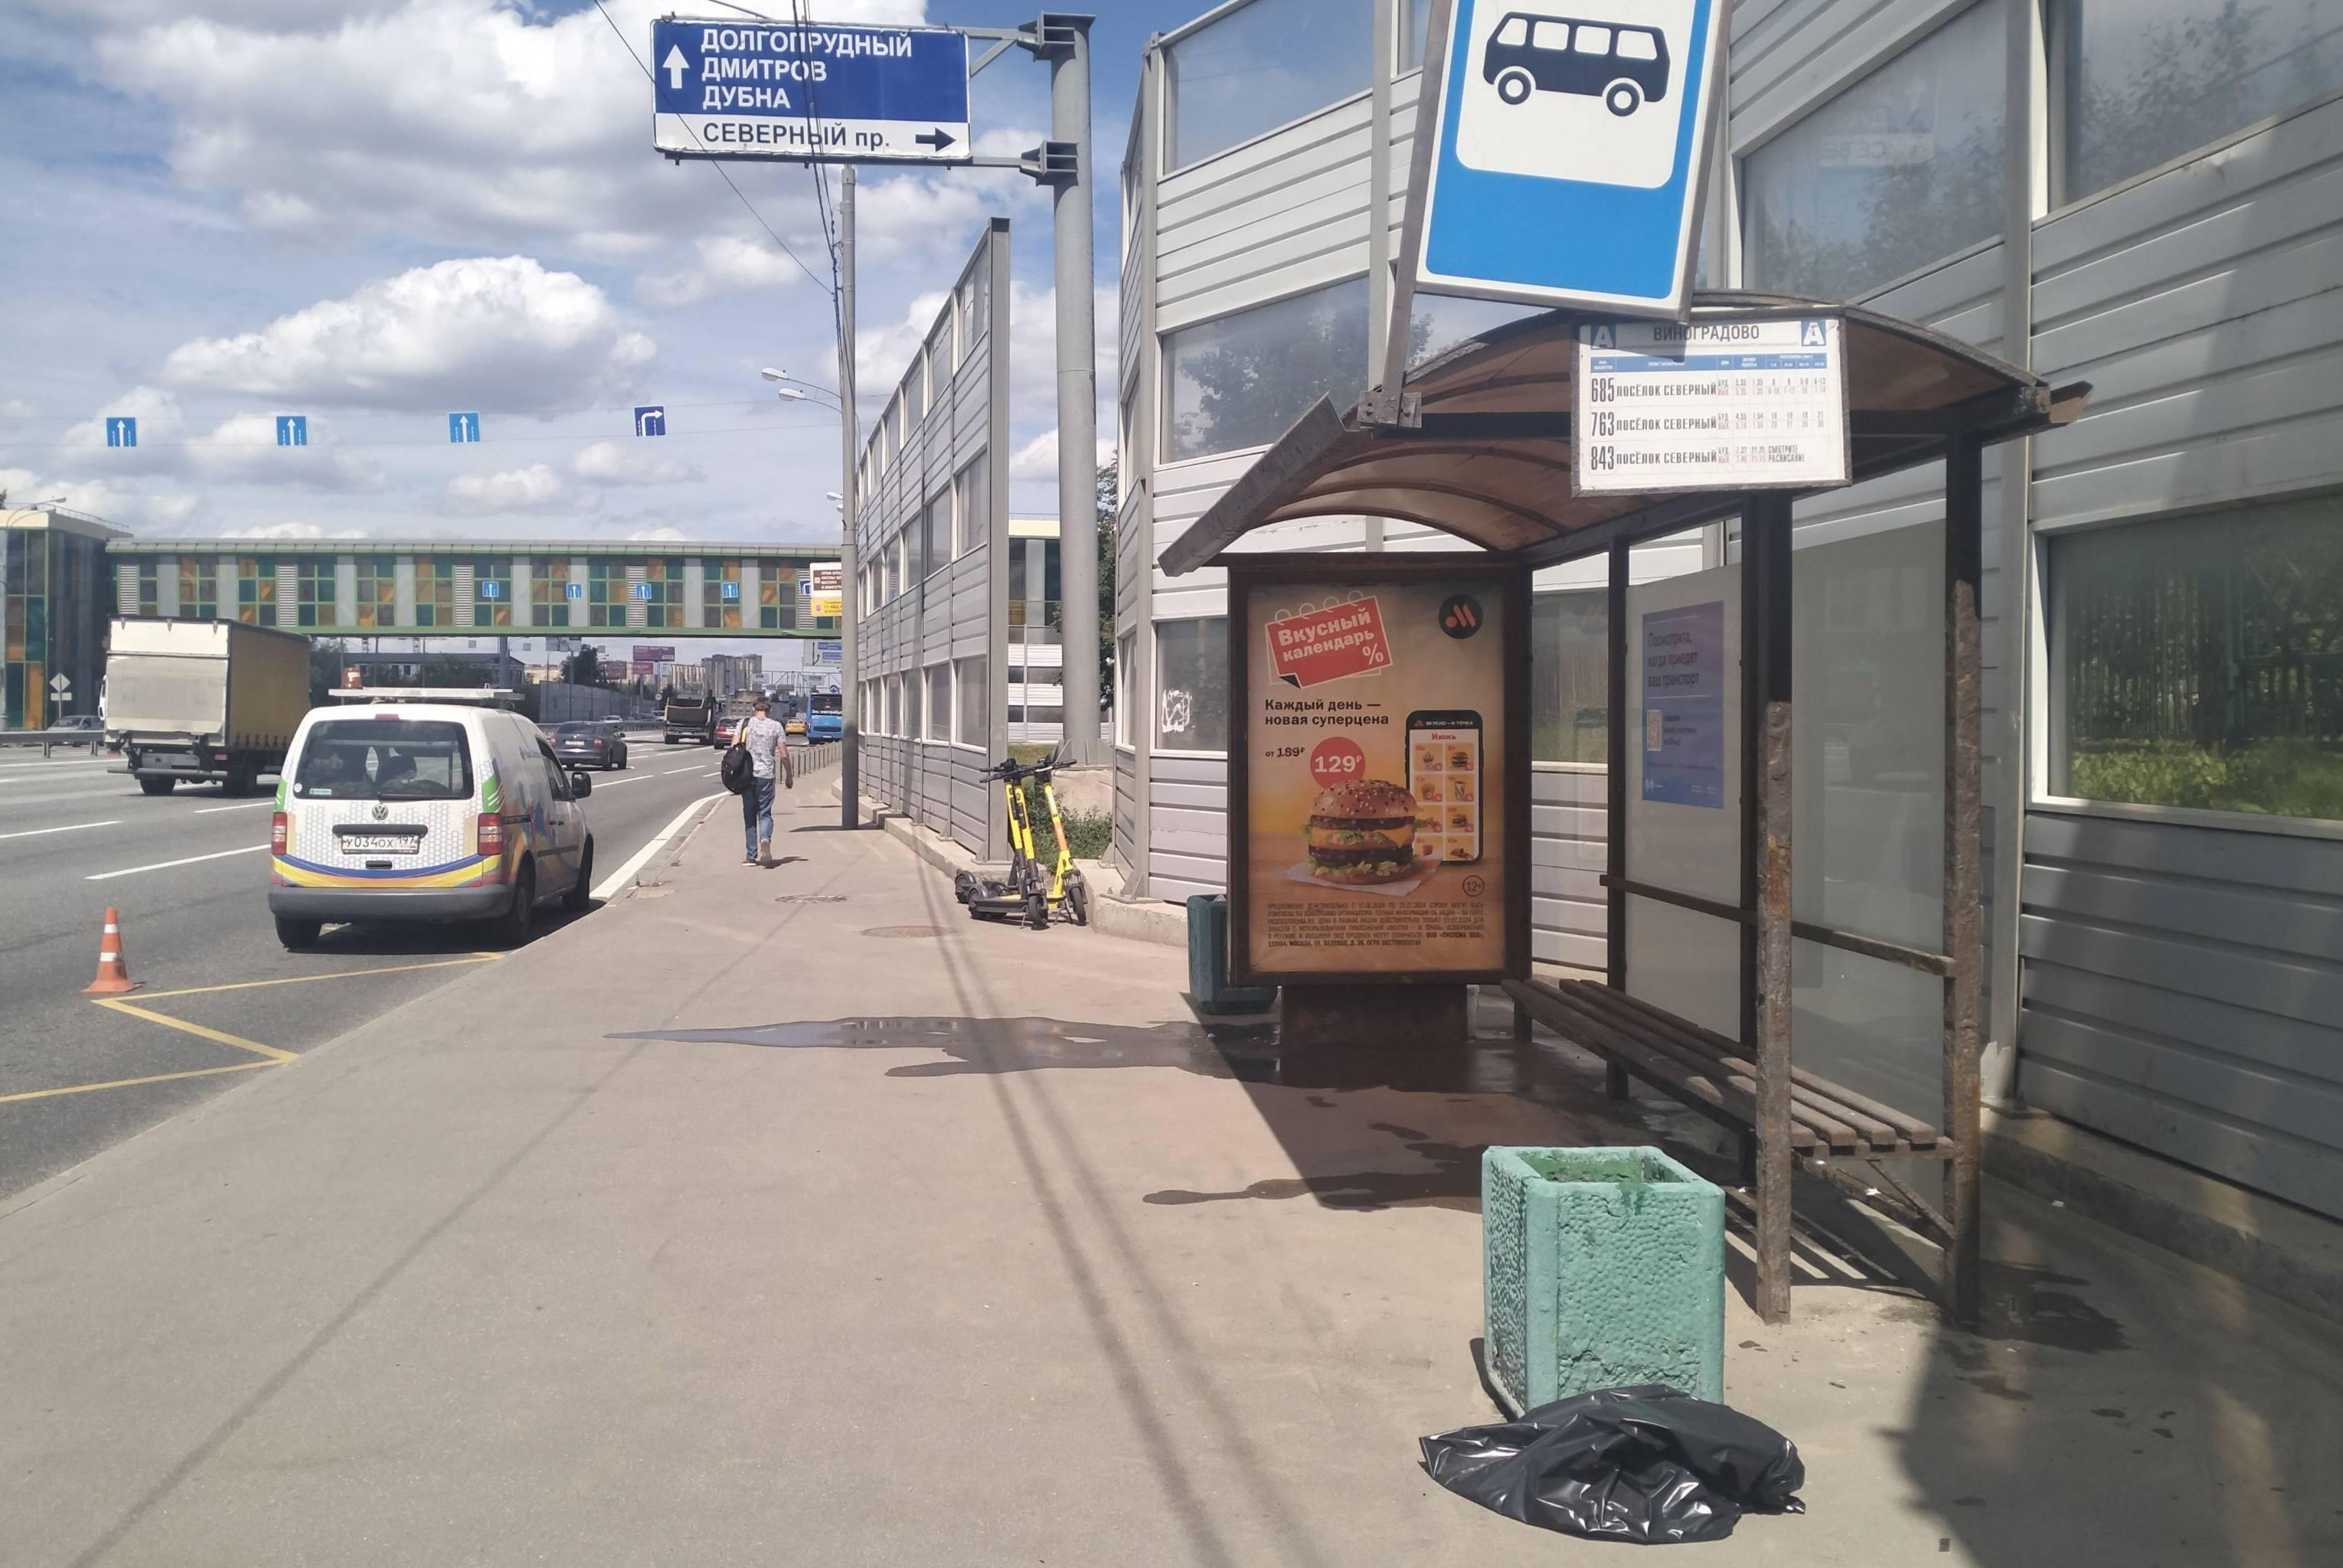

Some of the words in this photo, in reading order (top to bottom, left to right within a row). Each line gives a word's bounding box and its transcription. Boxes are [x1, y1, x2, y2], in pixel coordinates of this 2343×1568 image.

[701, 29, 912, 58] ДОЛГОПРУДНЫЙ
[701, 57, 827, 82] ДМИТРОВ
[702, 86, 791, 109] ДУБНА
[703, 122, 847, 146] СЕВЕРНЫЙ
[855, 131, 890, 151] пр.
[1654, 325, 1760, 341] ВИНОГРАДОВО
[1591, 377, 1615, 402] 685
[1664, 381, 1717, 396] СЕВЕРНЫЙ
[1591, 412, 1615, 436] 763
[1664, 416, 1717, 430] СЕВЕРНЫЙ
[1591, 446, 1615, 470] 843
[1664, 450, 1717, 465] СЕВЕРНЫЙ
[1277, 606, 1371, 647] Вкусный
[1283, 630, 1374, 662] календарь
[1264, 699, 1324, 711] Каждый
[1328, 701, 1362, 711] день
[1265, 716, 1308, 725] новая
[1312, 714, 1389, 727] суперцена
[1466, 880, 1482, 892] 12+
